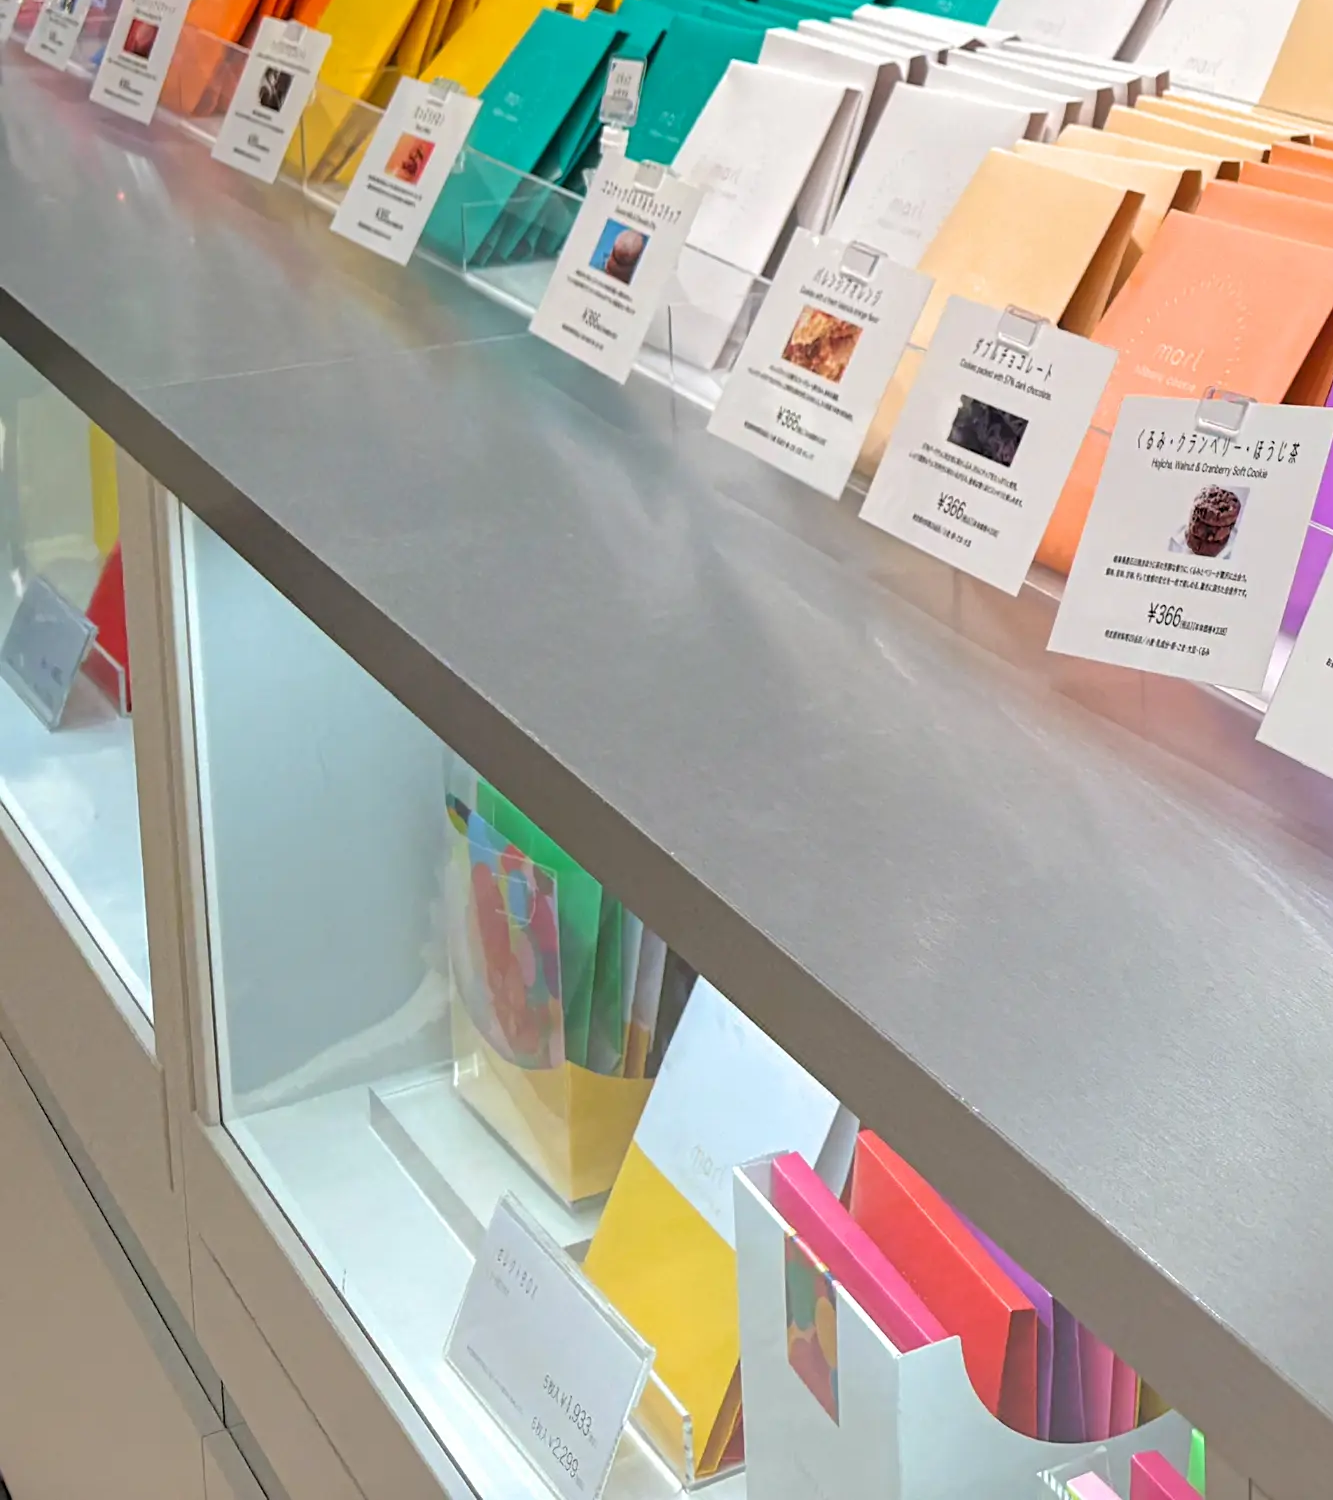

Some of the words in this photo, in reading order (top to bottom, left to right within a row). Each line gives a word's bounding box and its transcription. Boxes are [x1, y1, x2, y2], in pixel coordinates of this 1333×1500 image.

[1154, 343, 1205, 373] marl
[1174, 460, 1195, 472] Walnut
[1194, 462, 1201, 473] &
[1201, 462, 1232, 477] Cranberry
[1232, 465, 1247, 477] Soft
[1246, 466, 1268, 479] Cookie
[937, 492, 967, 520] ¥366
[1147, 602, 1184, 628] ¥366
